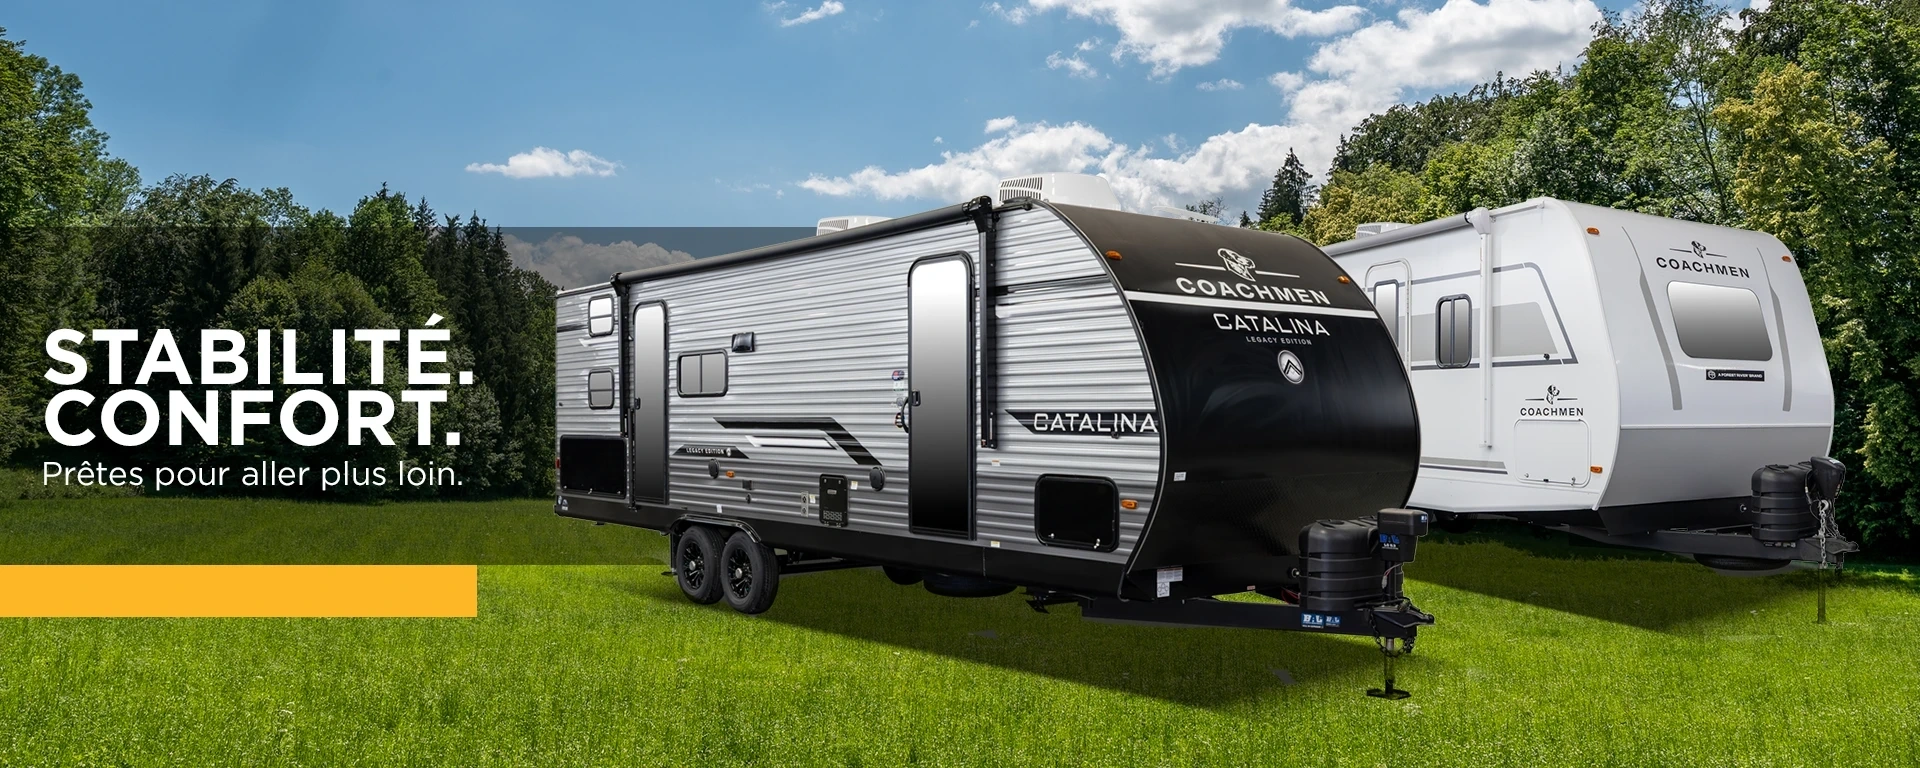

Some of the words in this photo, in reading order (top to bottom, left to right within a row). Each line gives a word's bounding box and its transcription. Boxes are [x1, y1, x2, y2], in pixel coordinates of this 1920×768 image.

[1656, 257, 1750, 278] COACHMEN
[1175, 276, 1331, 305] COACHMEN
[1212, 313, 1330, 336] CATALINA
[1245, 336, 1278, 344] LEGACY
[1280, 337, 1313, 346] EDITION
[1520, 407, 1584, 416] COACHMEN
[1033, 413, 1159, 433] CATALINA
